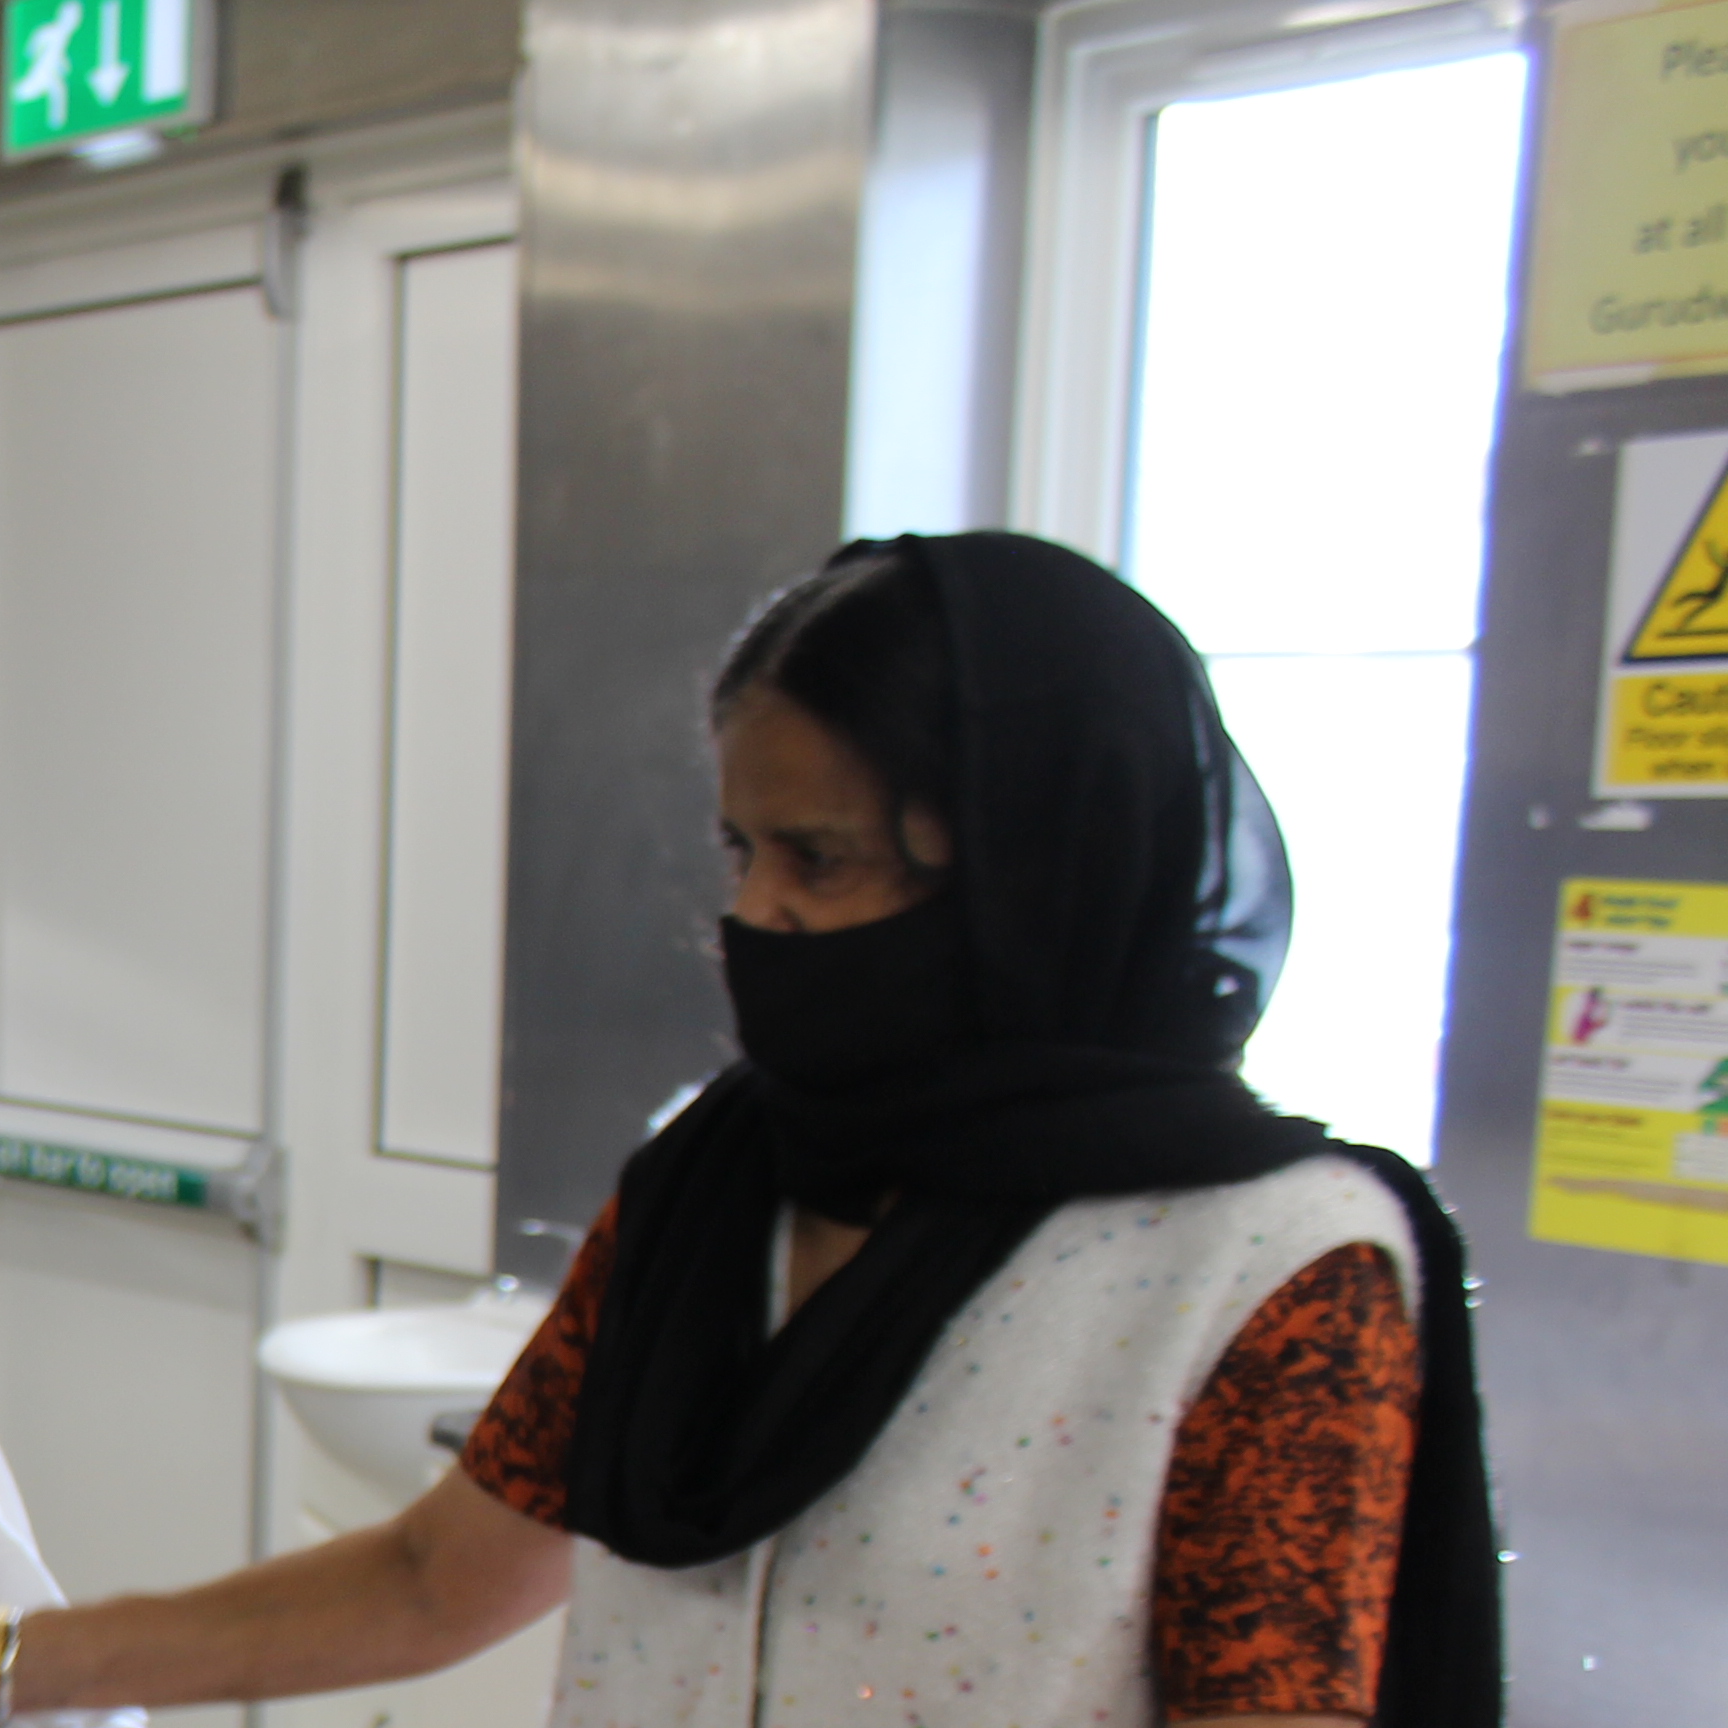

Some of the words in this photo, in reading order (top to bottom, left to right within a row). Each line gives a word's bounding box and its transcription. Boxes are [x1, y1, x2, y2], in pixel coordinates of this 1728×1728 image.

[1633, 214, 1674, 254] at
[28, 1144, 75, 1181] bar
[76, 1150, 105, 1187] to
[107, 1162, 179, 1201] open
